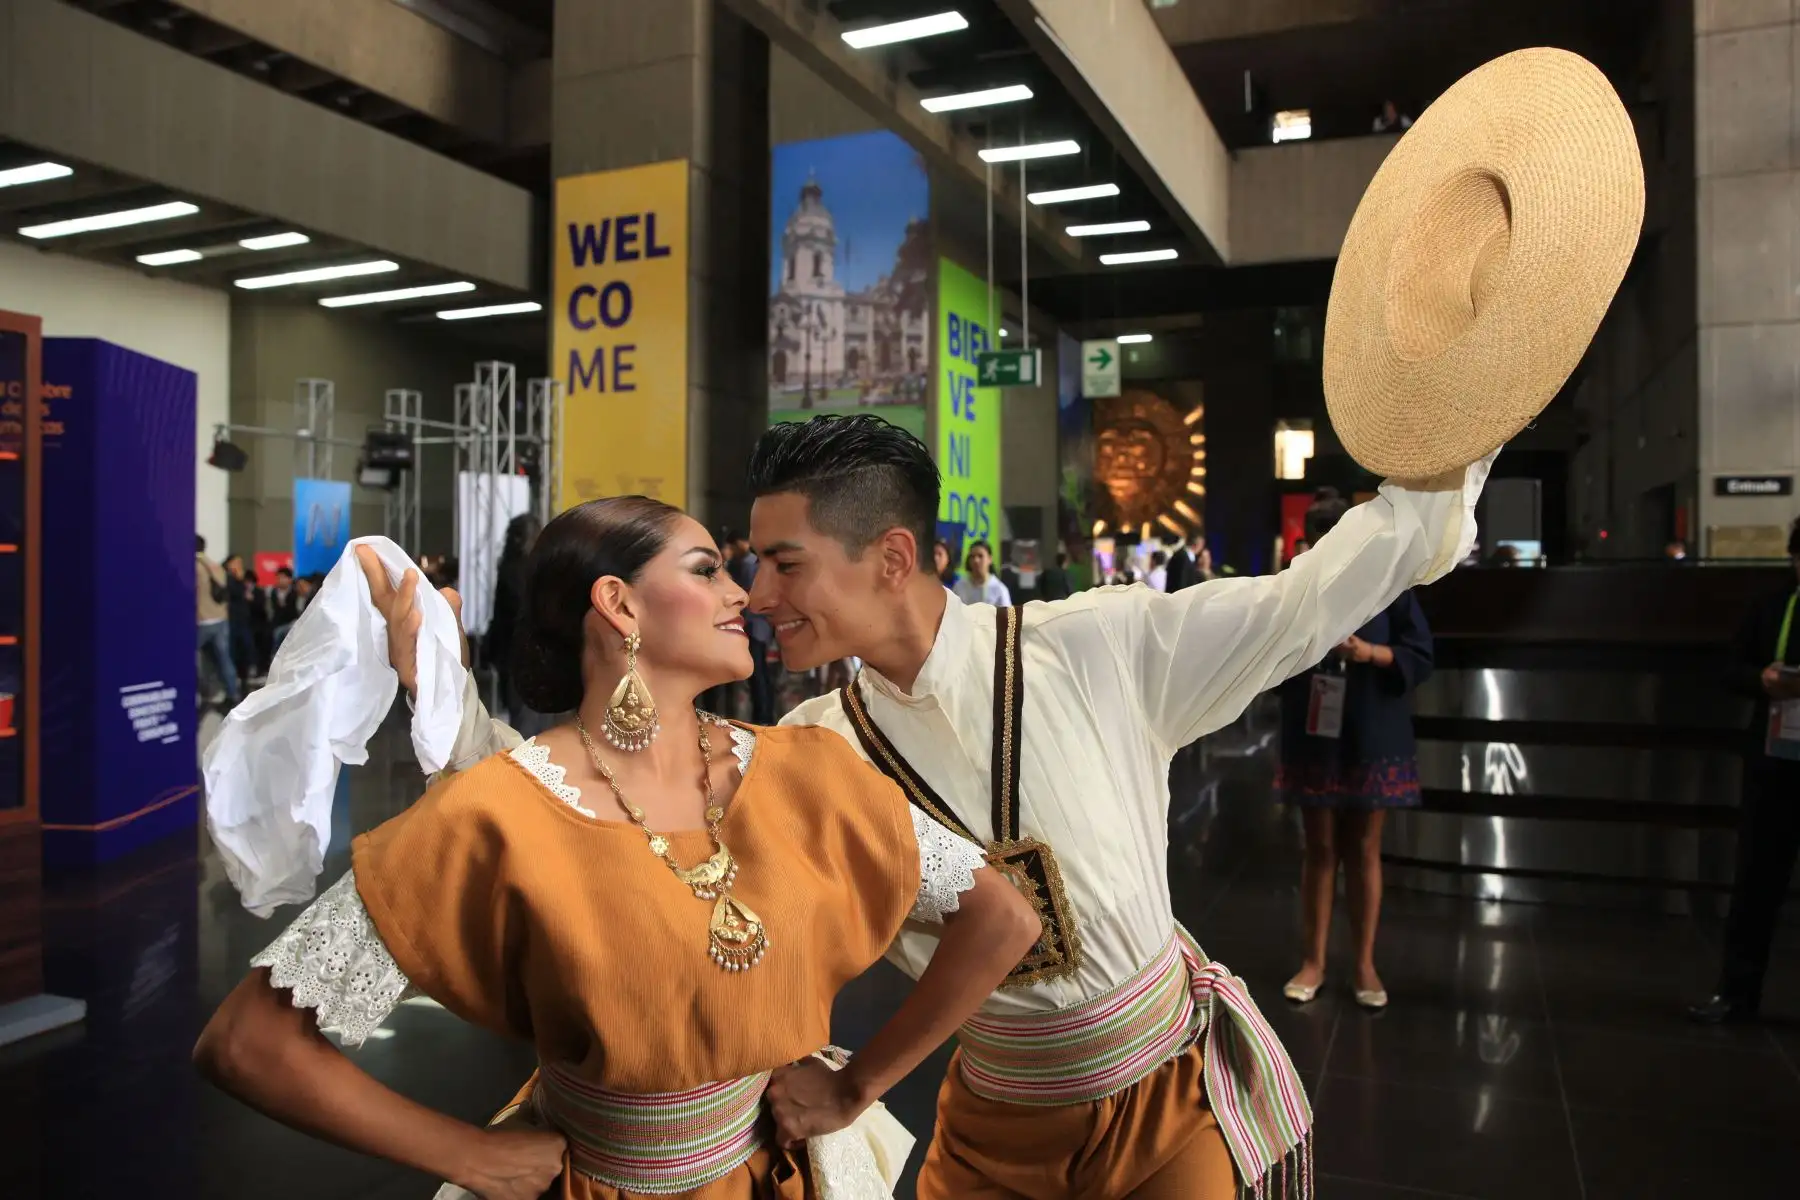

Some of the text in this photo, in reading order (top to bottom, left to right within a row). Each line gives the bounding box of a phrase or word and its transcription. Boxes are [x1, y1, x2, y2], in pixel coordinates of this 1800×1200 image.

[567, 212, 671, 268] WEL
[567, 280, 633, 331] CO
[567, 344, 637, 396] ME
[948, 371, 976, 423] VE
[948, 431, 971, 478] NI
[949, 492, 990, 540] DOS
